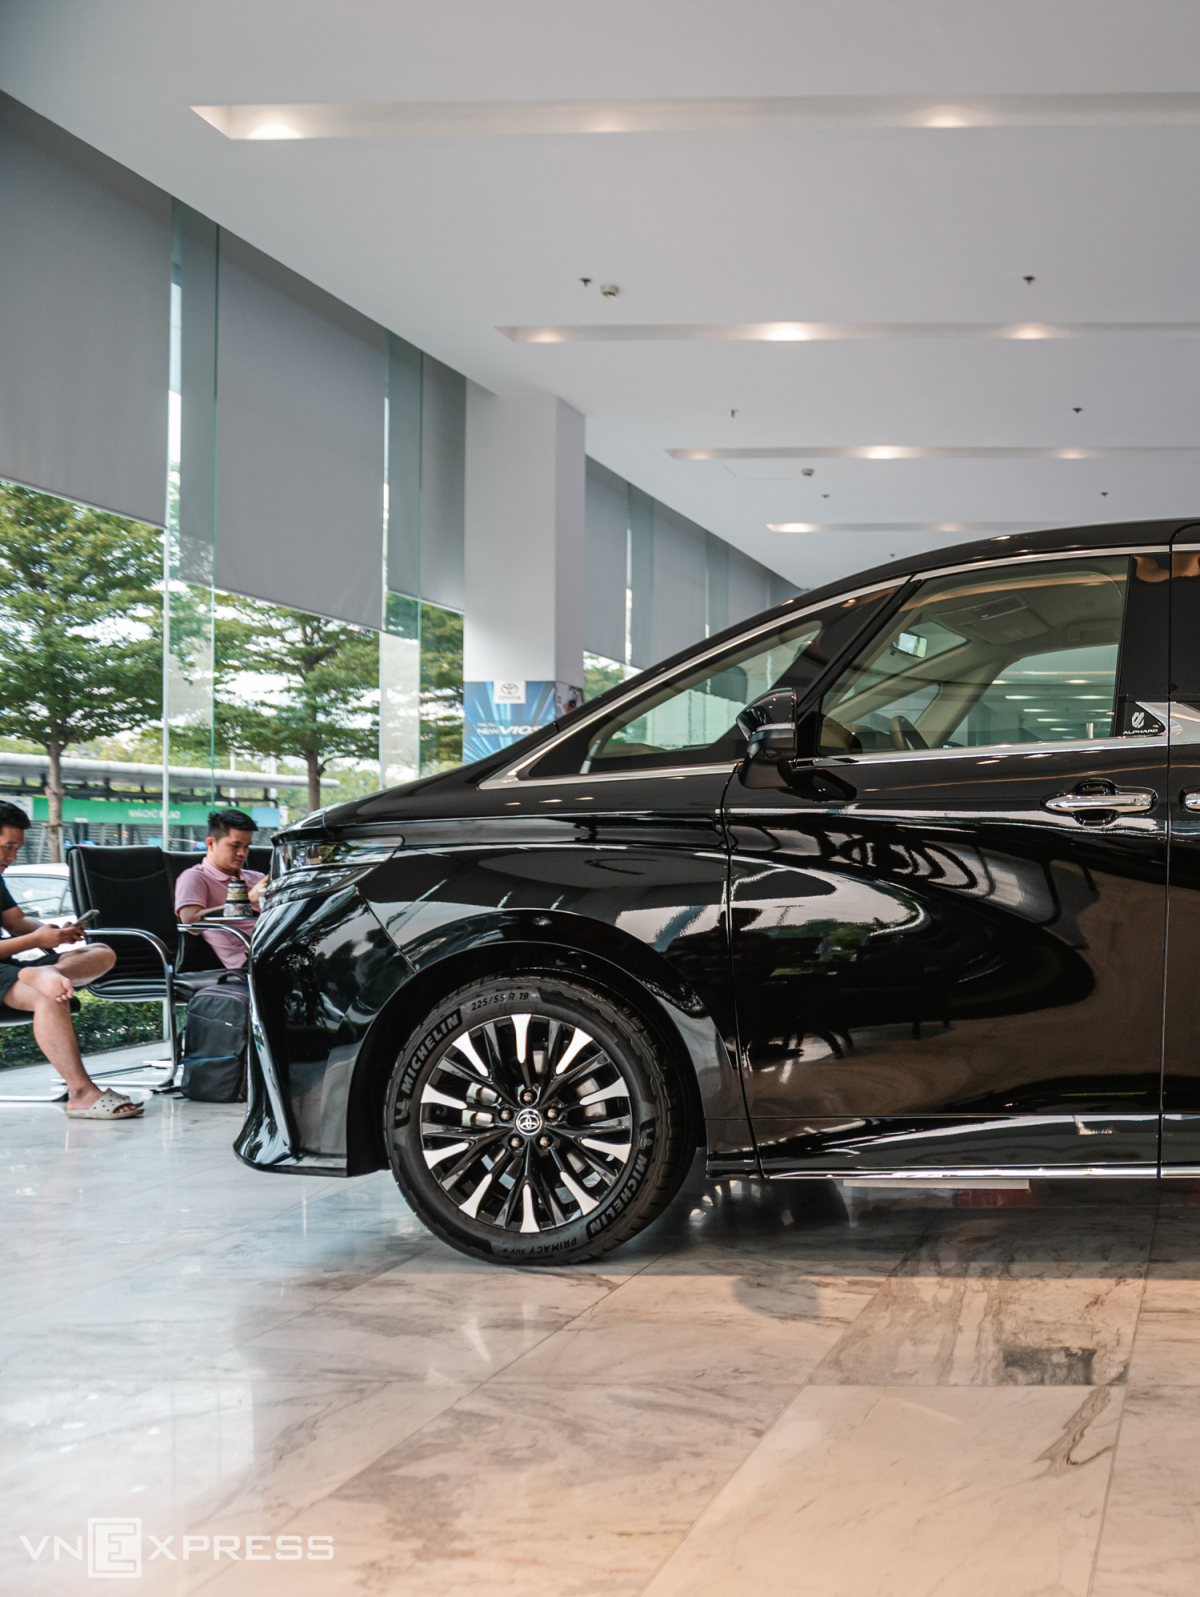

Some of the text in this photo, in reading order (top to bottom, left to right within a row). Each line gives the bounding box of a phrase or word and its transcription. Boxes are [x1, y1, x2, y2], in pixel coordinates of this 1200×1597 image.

[471, 992, 530, 1011] 225/55 R 19
[401, 1013, 459, 1094] MICHELIN
[589, 1153, 648, 1234] MICHELIN
[528, 1237, 577, 1255] PRIMACY
